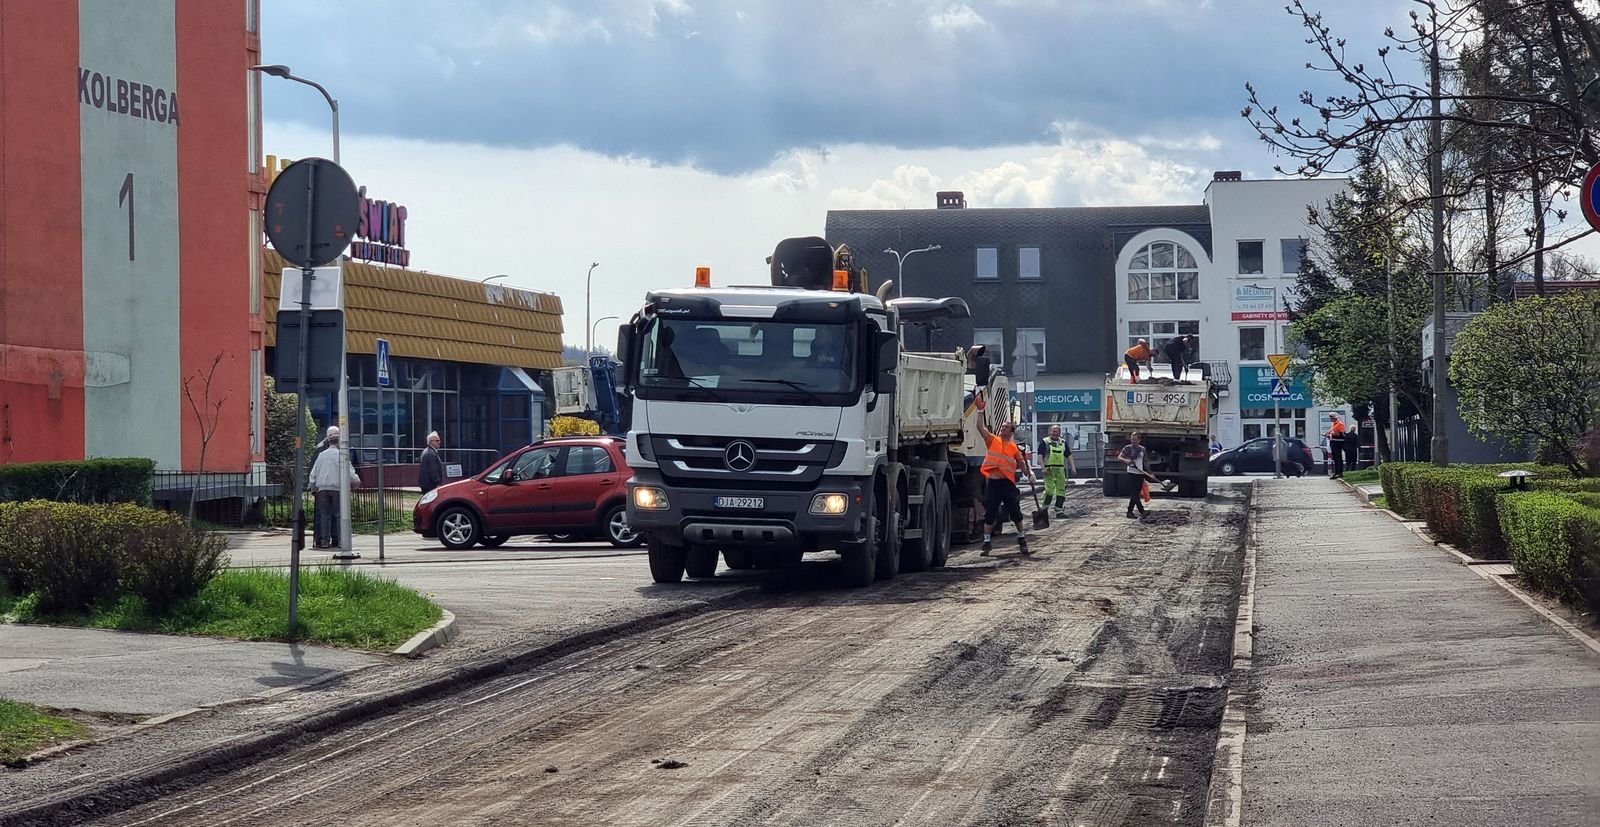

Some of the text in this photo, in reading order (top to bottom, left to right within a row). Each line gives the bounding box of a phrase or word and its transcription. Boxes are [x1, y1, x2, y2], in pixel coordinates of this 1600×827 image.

[78, 65, 180, 126] KOLBERGA
[118, 172, 135, 261] 1
[1136, 393, 1154, 404] DJE
[719, 497, 763, 508] DJA 29212
